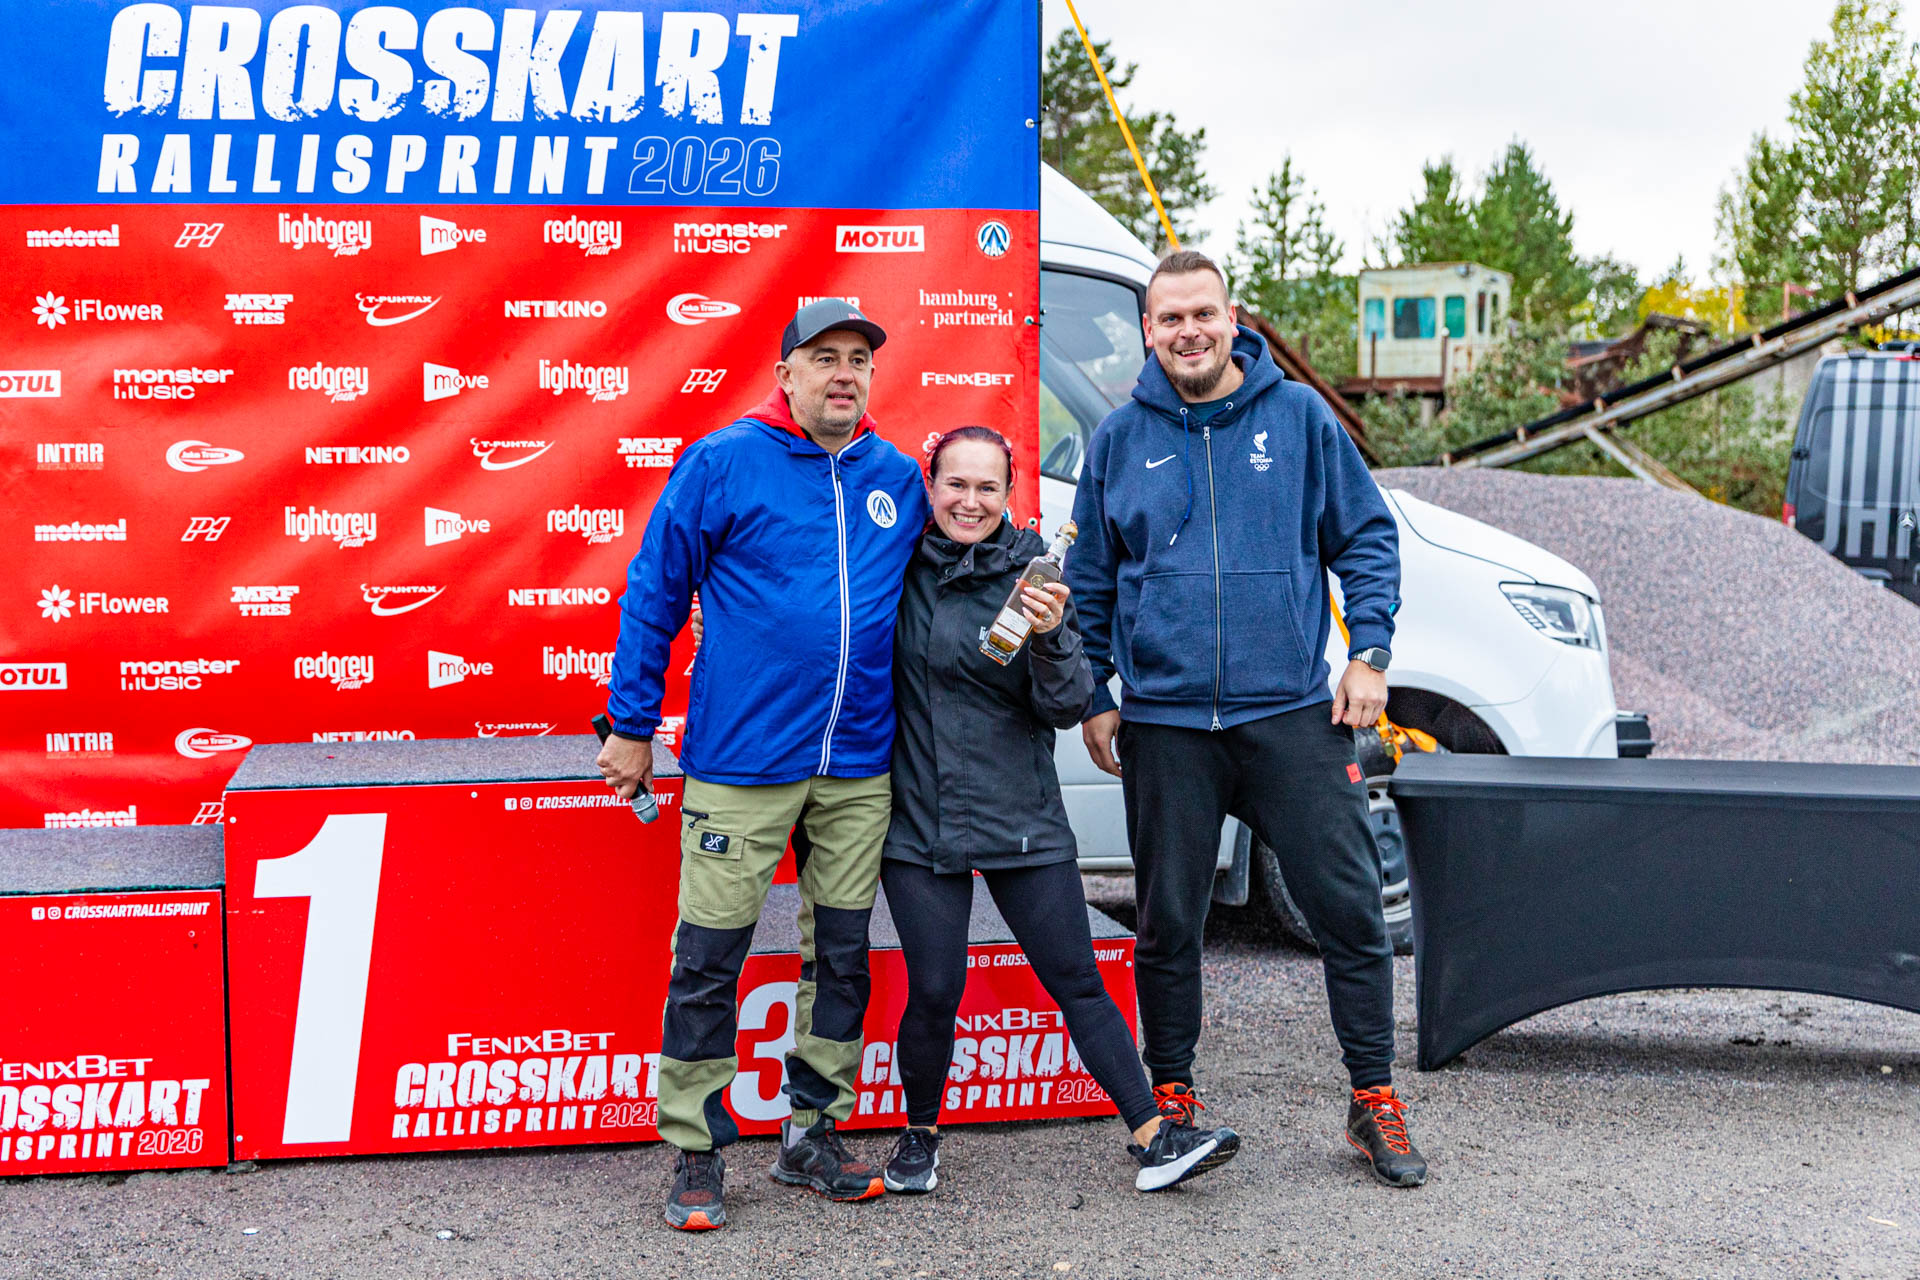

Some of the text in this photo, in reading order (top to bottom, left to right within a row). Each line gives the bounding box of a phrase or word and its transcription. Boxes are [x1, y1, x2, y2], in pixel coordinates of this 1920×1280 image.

[104, 3, 799, 126] CROSSKART
[98, 134, 782, 196] RALLISPRINT 2026
[27, 224, 119, 247] motoral
[278, 213, 371, 249] lightgrey
[431, 228, 487, 244] move
[543, 215, 621, 249] redgrey
[674, 222, 788, 238] monster
[841, 231, 919, 247] MOTUL
[224, 294, 293, 311] MRF
[919, 289, 998, 310] hamburg
[233, 311, 285, 324] TYRES
[934, 308, 1013, 328] partnerid
[0, 376, 55, 392] OTUL
[114, 367, 233, 383] monster
[288, 362, 369, 395] redgrey
[434, 372, 489, 390] move
[539, 359, 629, 395] lightgrey
[37, 443, 104, 463] INTAR
[617, 438, 682, 454] MRF
[626, 454, 673, 467] TYRES
[35, 519, 126, 541] motoral
[285, 506, 376, 541] lightgrey
[436, 518, 490, 535] move
[547, 504, 624, 537] redgrey
[230, 586, 299, 602] MRF
[240, 604, 291, 616] TYRES
[121, 659, 240, 675] monster
[294, 651, 374, 684] redgrey
[438, 662, 493, 677] move
[543, 646, 615, 681] lightgr
[0, 668, 61, 685] OTUL
[46, 732, 114, 752] INTAR
[45, 805, 136, 828] motoral
[64, 902, 210, 920] CROSSKARTRALLISPRINT
[253, 813, 388, 1145] 1
[730, 982, 798, 1121] 3
[2, 1055, 153, 1081] ENIXBET
[395, 1053, 660, 1109] CROSSKART
[0, 1079, 210, 1133] OSSKART
[392, 1102, 657, 1138] RALLISPRINT 2026
[0, 1128, 203, 1162] ISPRINT 2026
